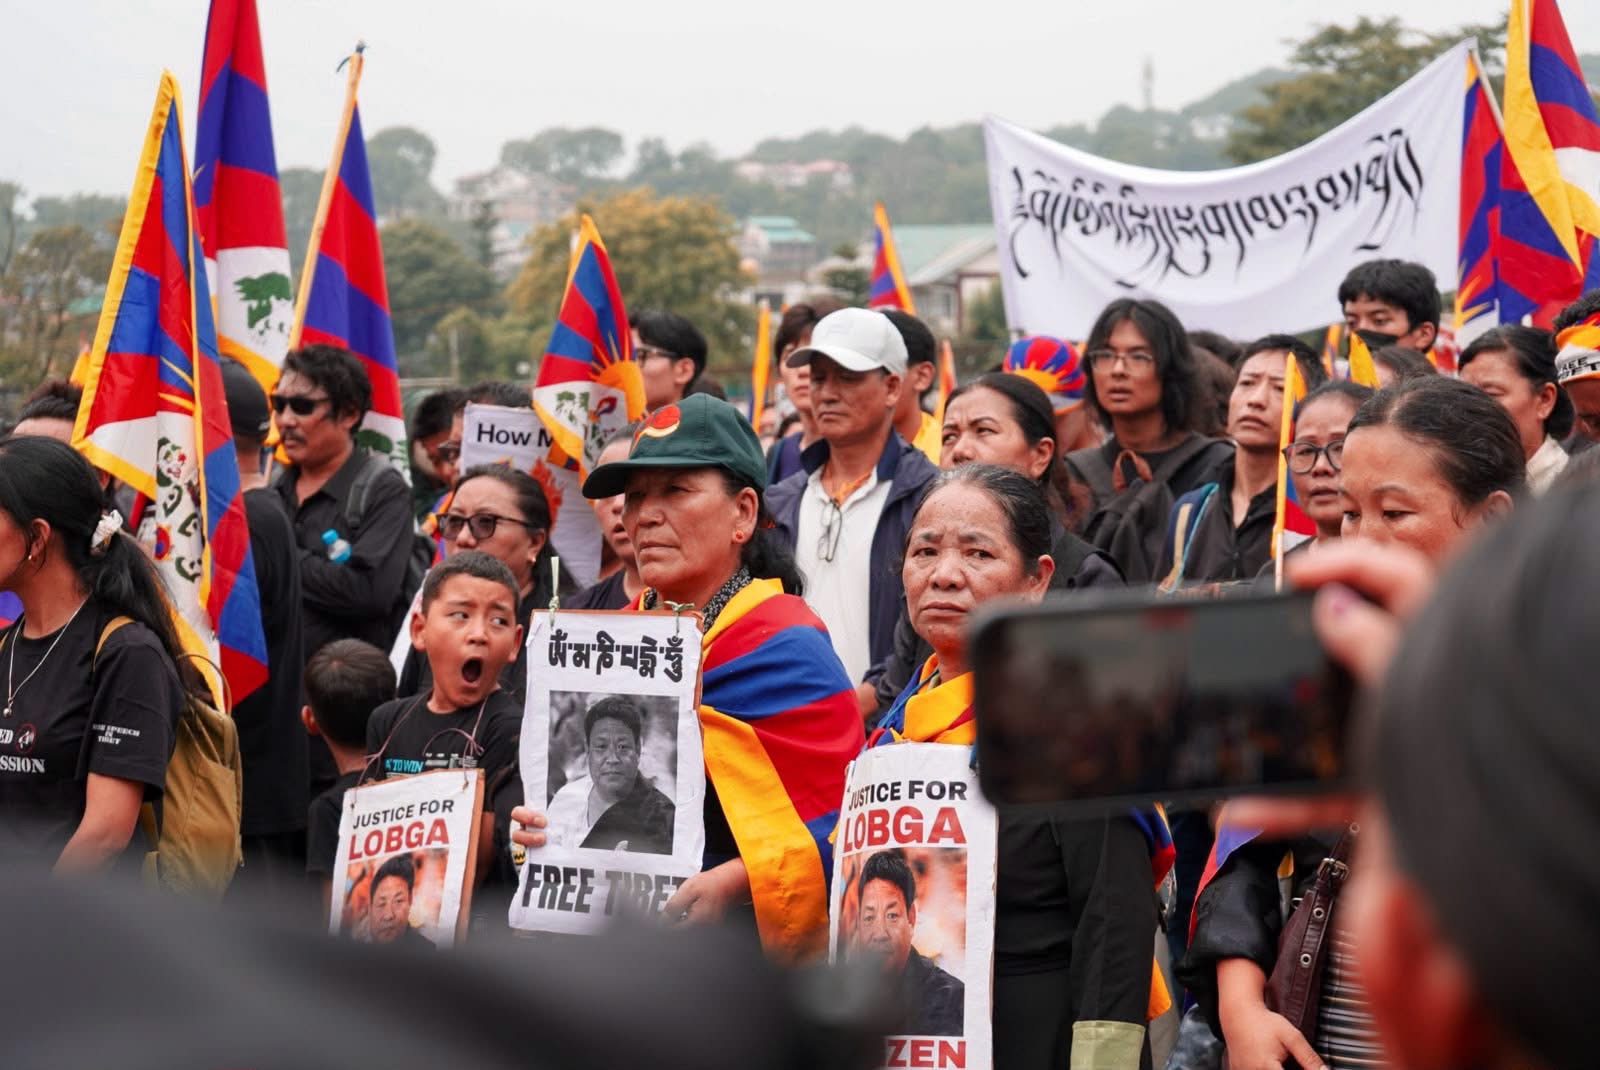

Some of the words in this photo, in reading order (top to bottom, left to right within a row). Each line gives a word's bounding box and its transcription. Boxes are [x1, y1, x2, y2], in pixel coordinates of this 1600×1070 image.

[477, 423, 531, 447] How
[538, 428, 554, 447] M
[0, 728, 14, 745] ED
[0, 755, 46, 773] SSION
[848, 781, 902, 811] JUSTICE
[908, 780, 968, 800] FOR
[353, 804, 415, 830] JUSTICE
[419, 799, 454, 816] FOR
[843, 806, 968, 853] LOBGA
[348, 818, 450, 861] LOBGA
[522, 863, 596, 914] FREE
[887, 1039, 967, 1069] ZEN
